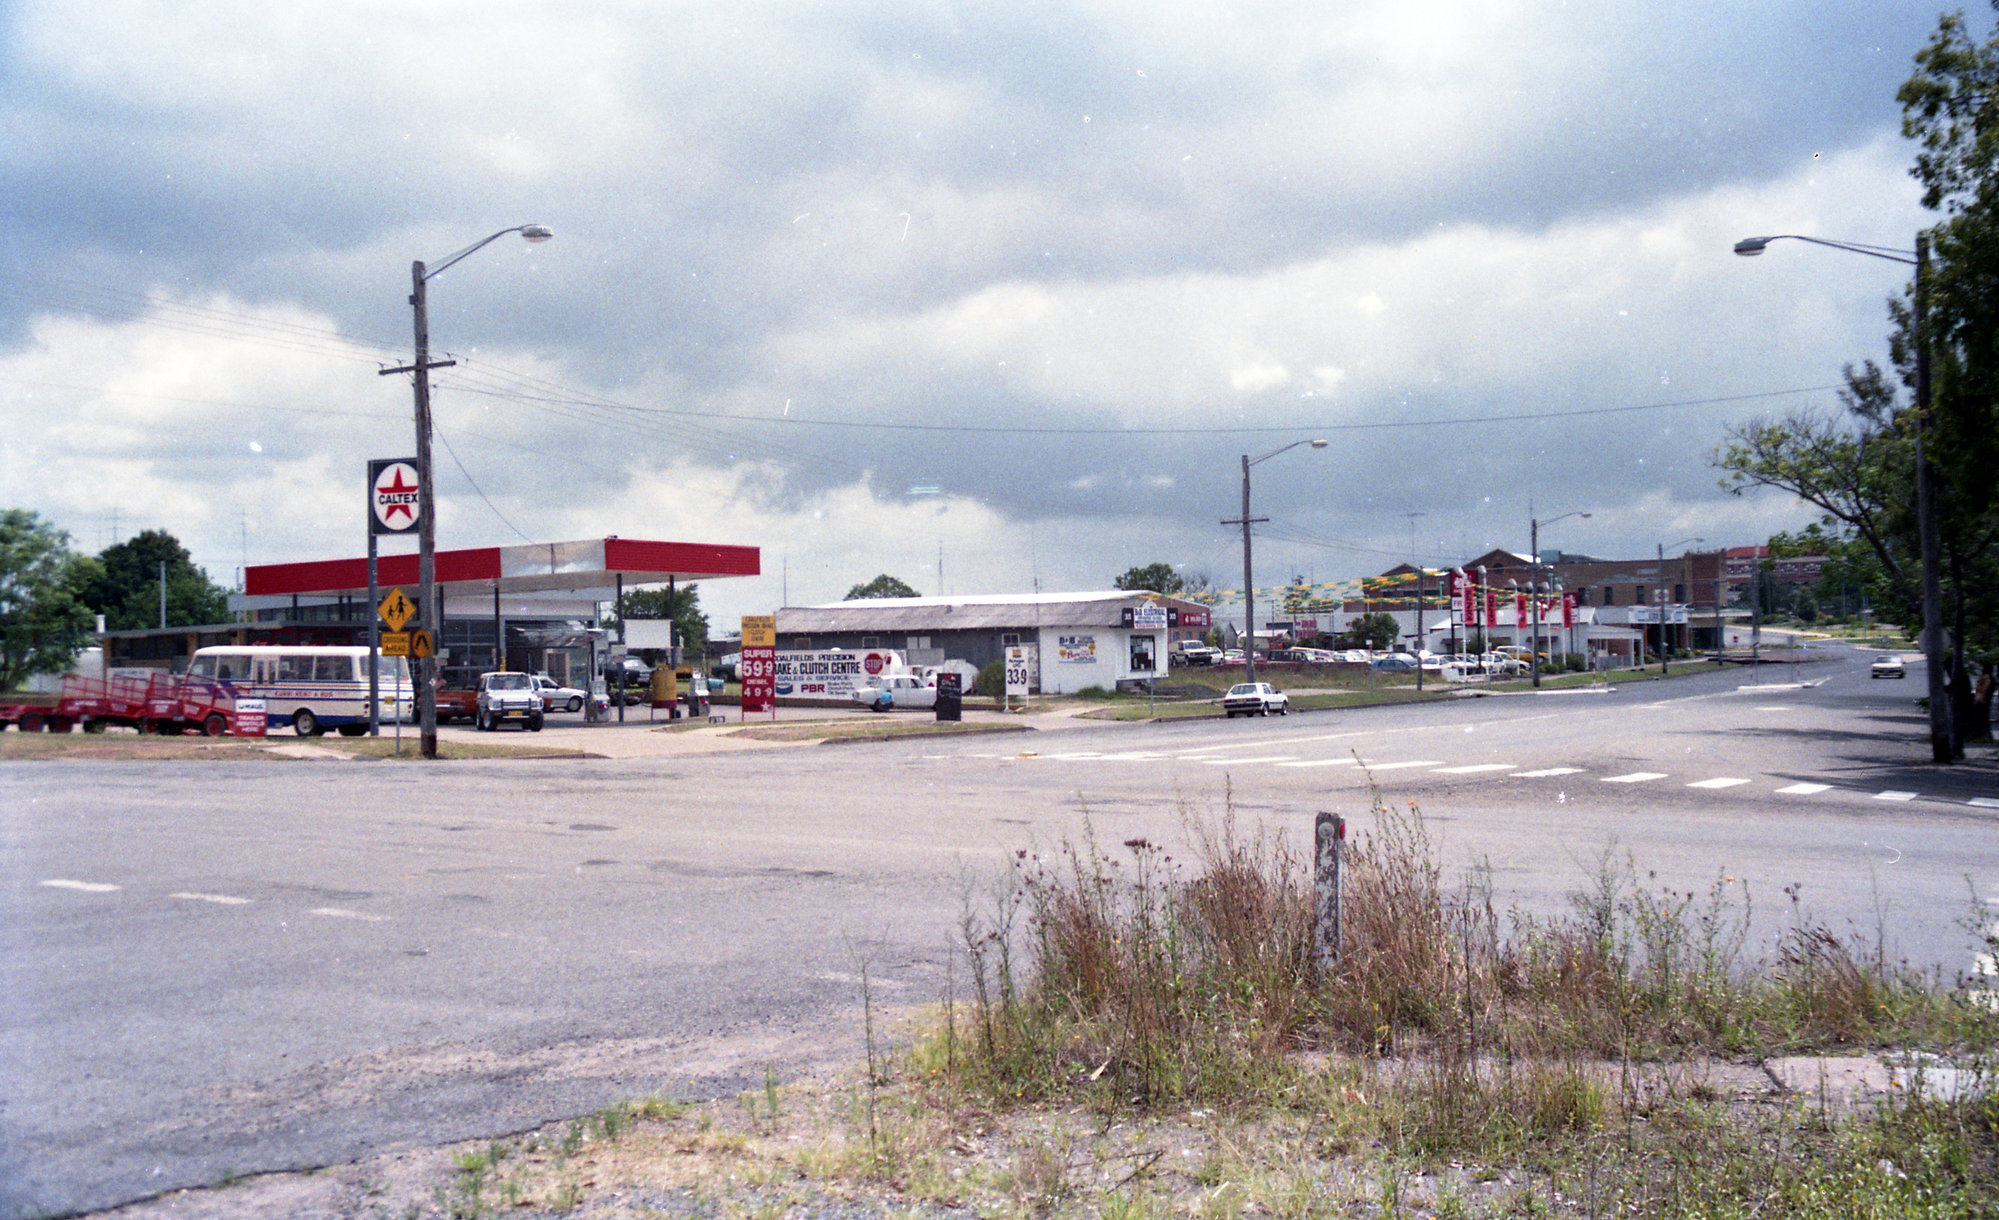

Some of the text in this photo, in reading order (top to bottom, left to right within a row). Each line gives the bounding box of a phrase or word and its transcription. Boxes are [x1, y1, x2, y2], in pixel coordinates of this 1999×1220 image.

[379, 494, 418, 504] CALTEX
[743, 649, 773, 658] SUPER
[774, 662, 792, 674] RAKE
[800, 662, 829, 674] CLUTCH
[831, 662, 860, 674] CENTRE
[866, 659, 882, 669] STOP
[801, 684, 825, 693] PBR
